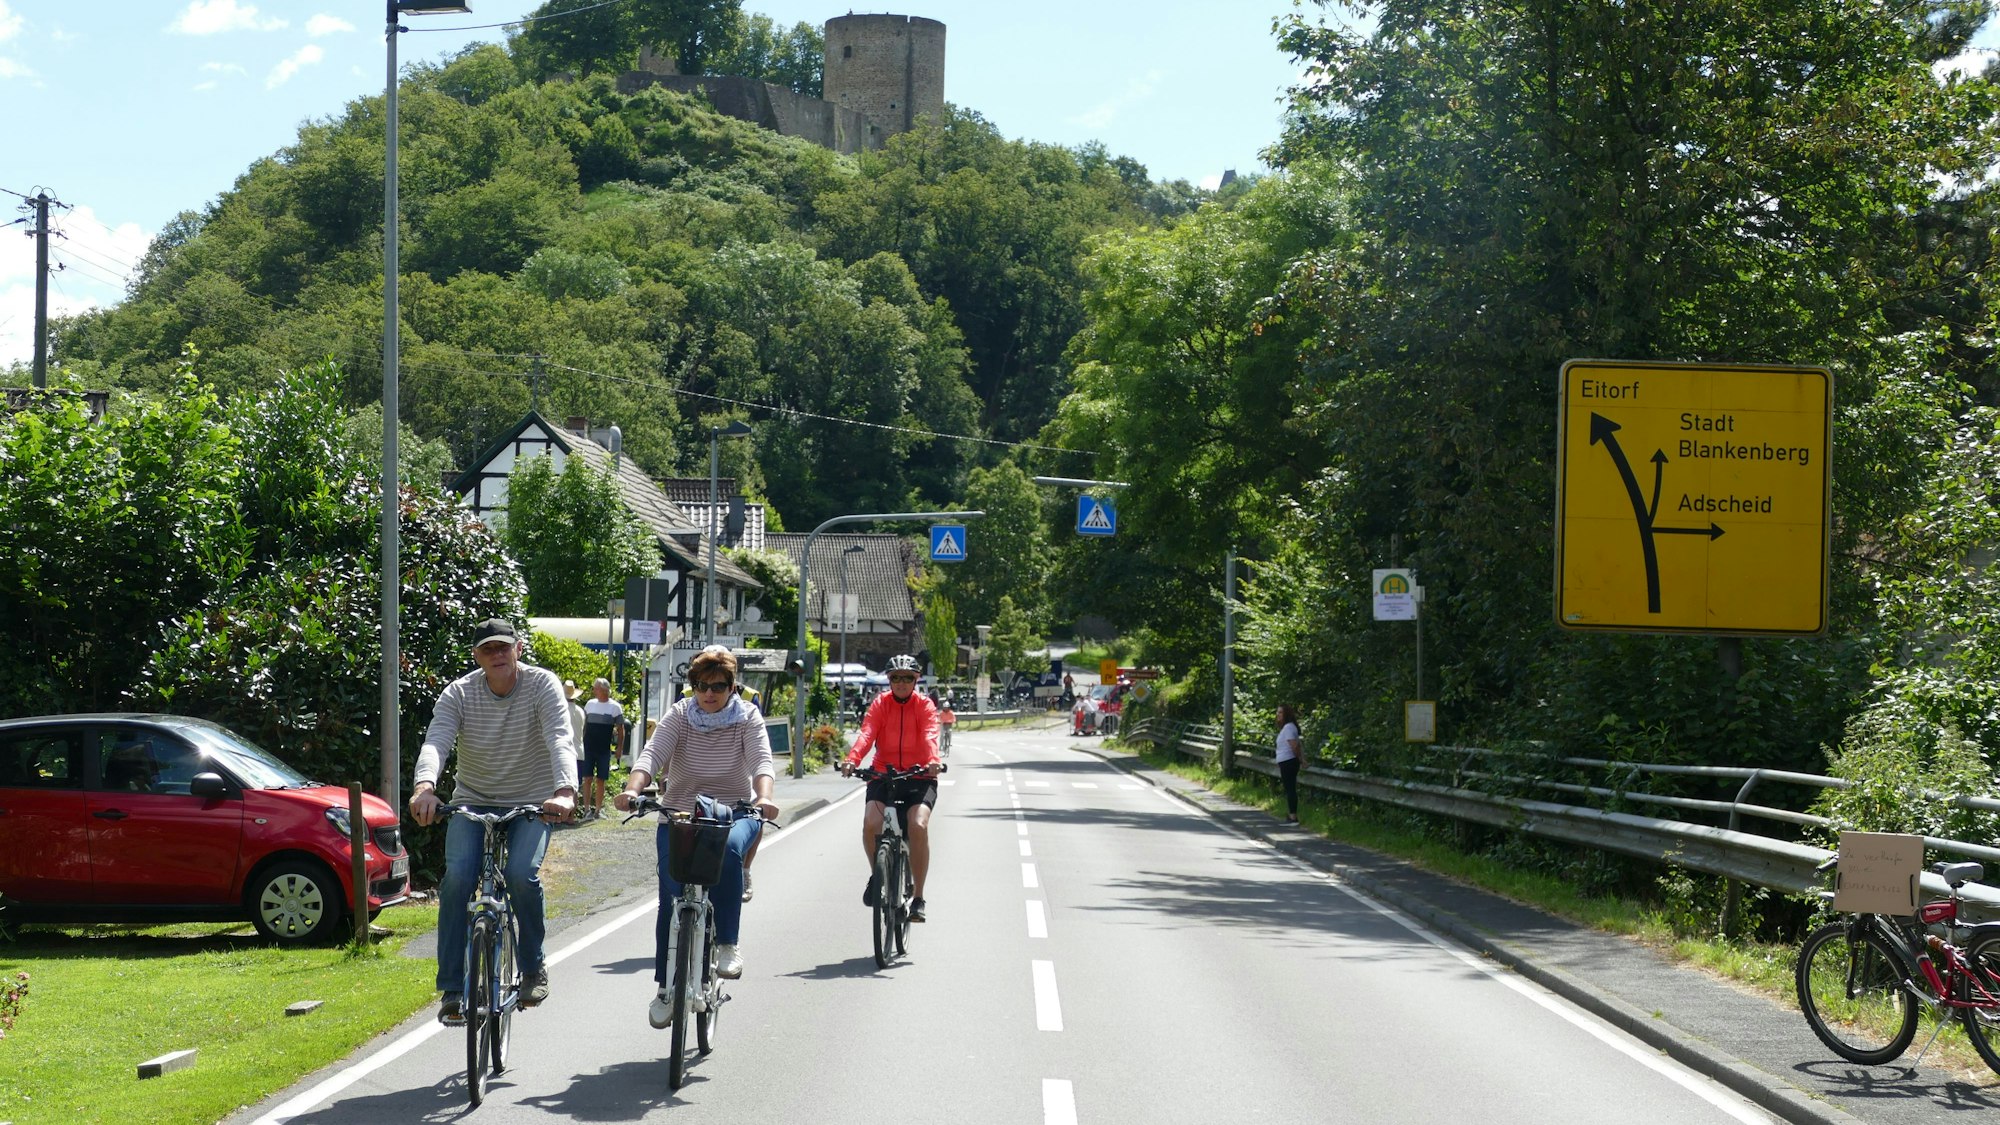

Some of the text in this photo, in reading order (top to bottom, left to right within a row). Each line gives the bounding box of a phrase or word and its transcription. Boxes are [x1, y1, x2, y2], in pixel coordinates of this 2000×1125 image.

[1582, 379, 1640, 399] Eitorf
[1680, 412, 1735, 432] Stadt
[1679, 439, 1809, 466] Blankenberg
[1678, 493, 1772, 513] Adscheid
[674, 641, 707, 650] BIKER
